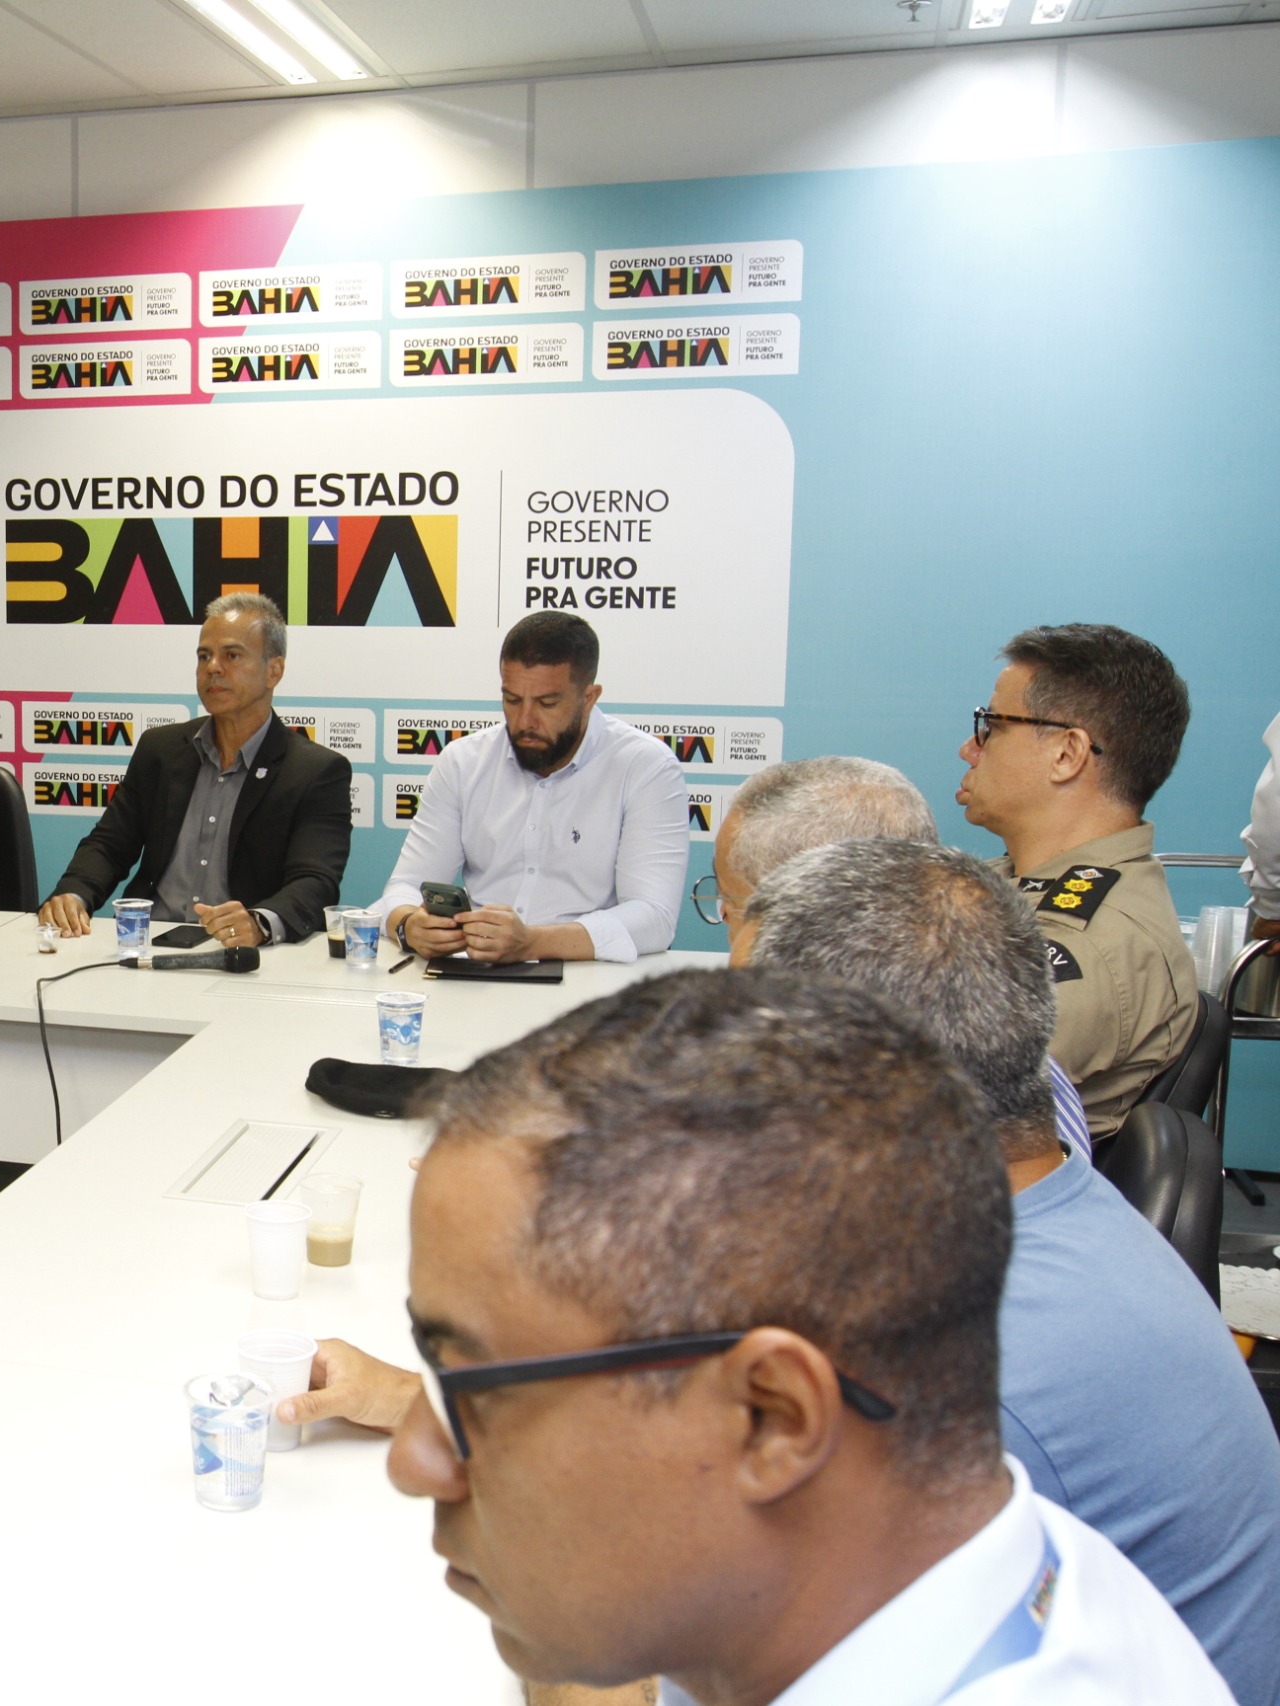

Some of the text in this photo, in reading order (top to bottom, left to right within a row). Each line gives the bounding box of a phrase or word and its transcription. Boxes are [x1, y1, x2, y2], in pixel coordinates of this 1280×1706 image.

[609, 253, 733, 269] GOVERNO DO ESTADO
[405, 265, 520, 280] GOVERNO DO ESTADO
[31, 285, 133, 299] GOVERNO DO ESTADO
[607, 326, 730, 340] GOVERNO DO ESTADO
[403, 335, 519, 348] GOVERNO DO ESTADO
[31, 350, 133, 363] GOVERNO DO ESTADO
[5, 471, 459, 511] GOVERNO DO ESTADO
[527, 489, 670, 514] GOVERNO
[527, 520, 652, 543] PRESENTE
[525, 557, 637, 580] FUTURO
[525, 587, 676, 610] PRA GENTE
[34, 710, 133, 720] GOVERNO DO ESTADO
[397, 719, 467, 728] GOVERNO DO
[653, 725, 670, 733] DO
[673, 725, 715, 734] ESTADO
[34, 772, 80, 781] GOVERNO
[82, 773, 96, 781] DO
[396, 784, 424, 793] GOVE
